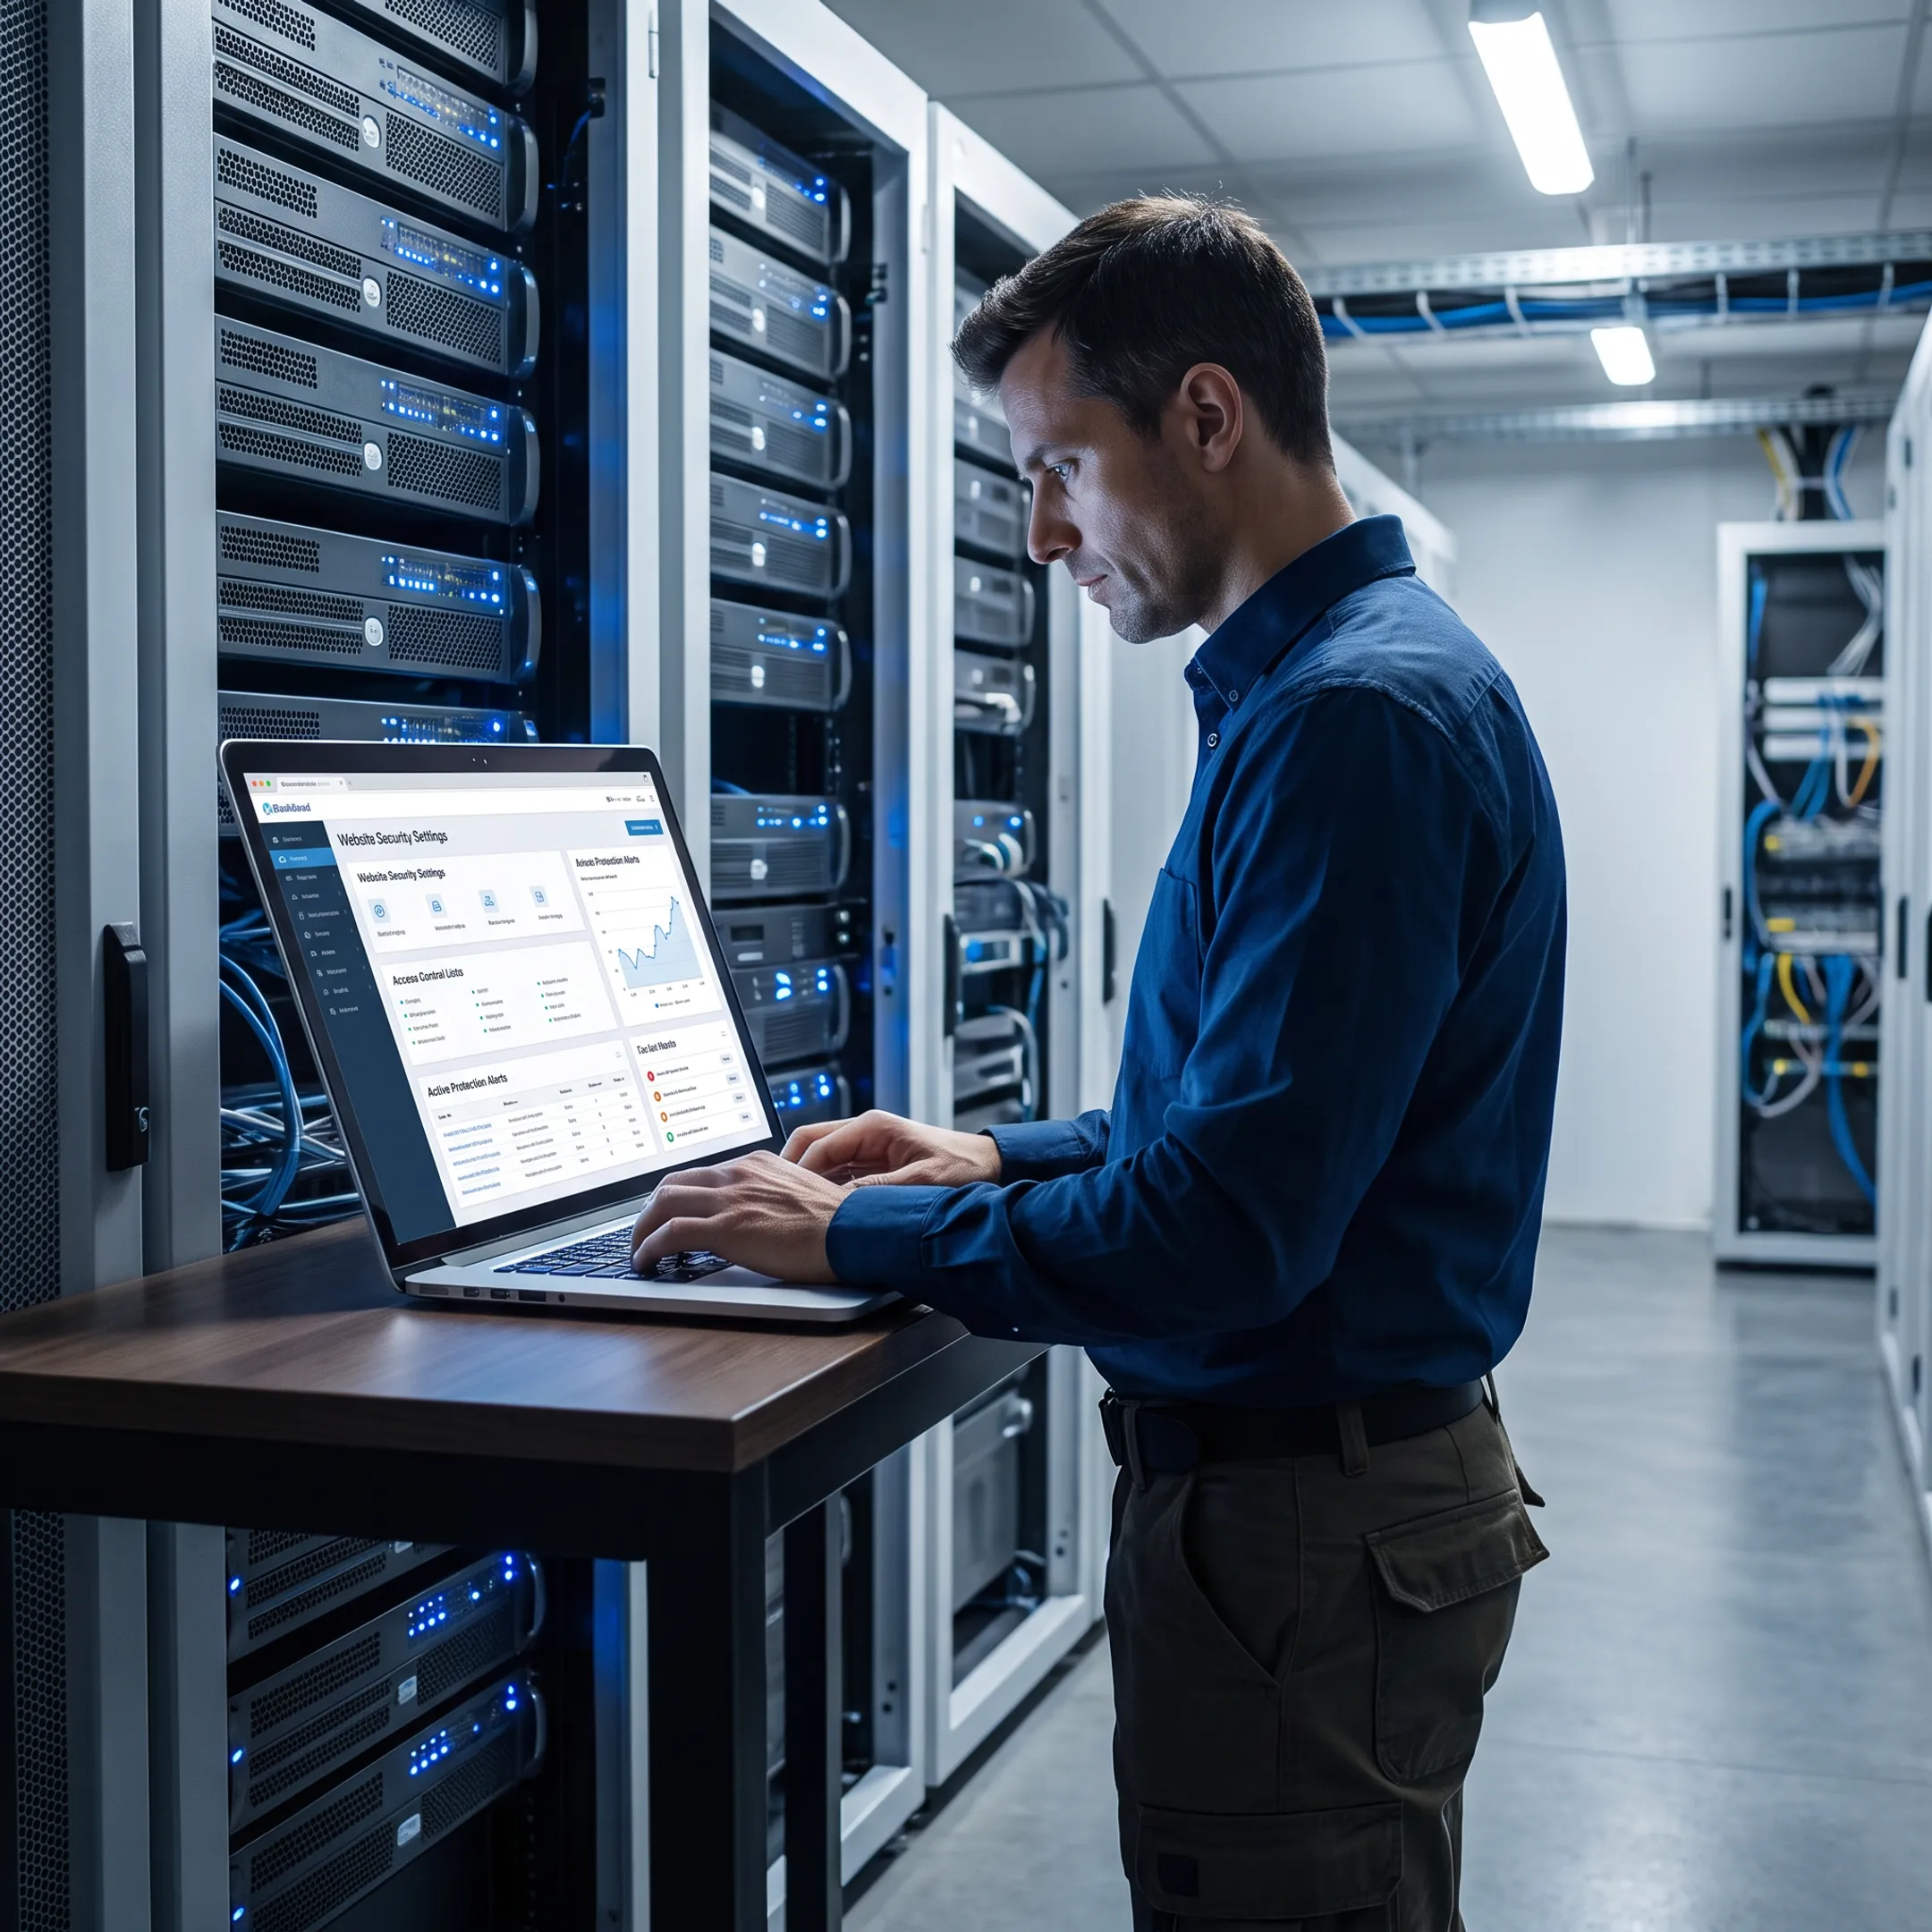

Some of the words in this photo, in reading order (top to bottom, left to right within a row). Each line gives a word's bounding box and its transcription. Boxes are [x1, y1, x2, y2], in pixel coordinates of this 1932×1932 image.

[337, 833, 376, 846] Website
[376, 831, 411, 845] Security
[412, 830, 448, 843] Settings
[387, 869, 417, 881] Security
[393, 975, 419, 986] Access
